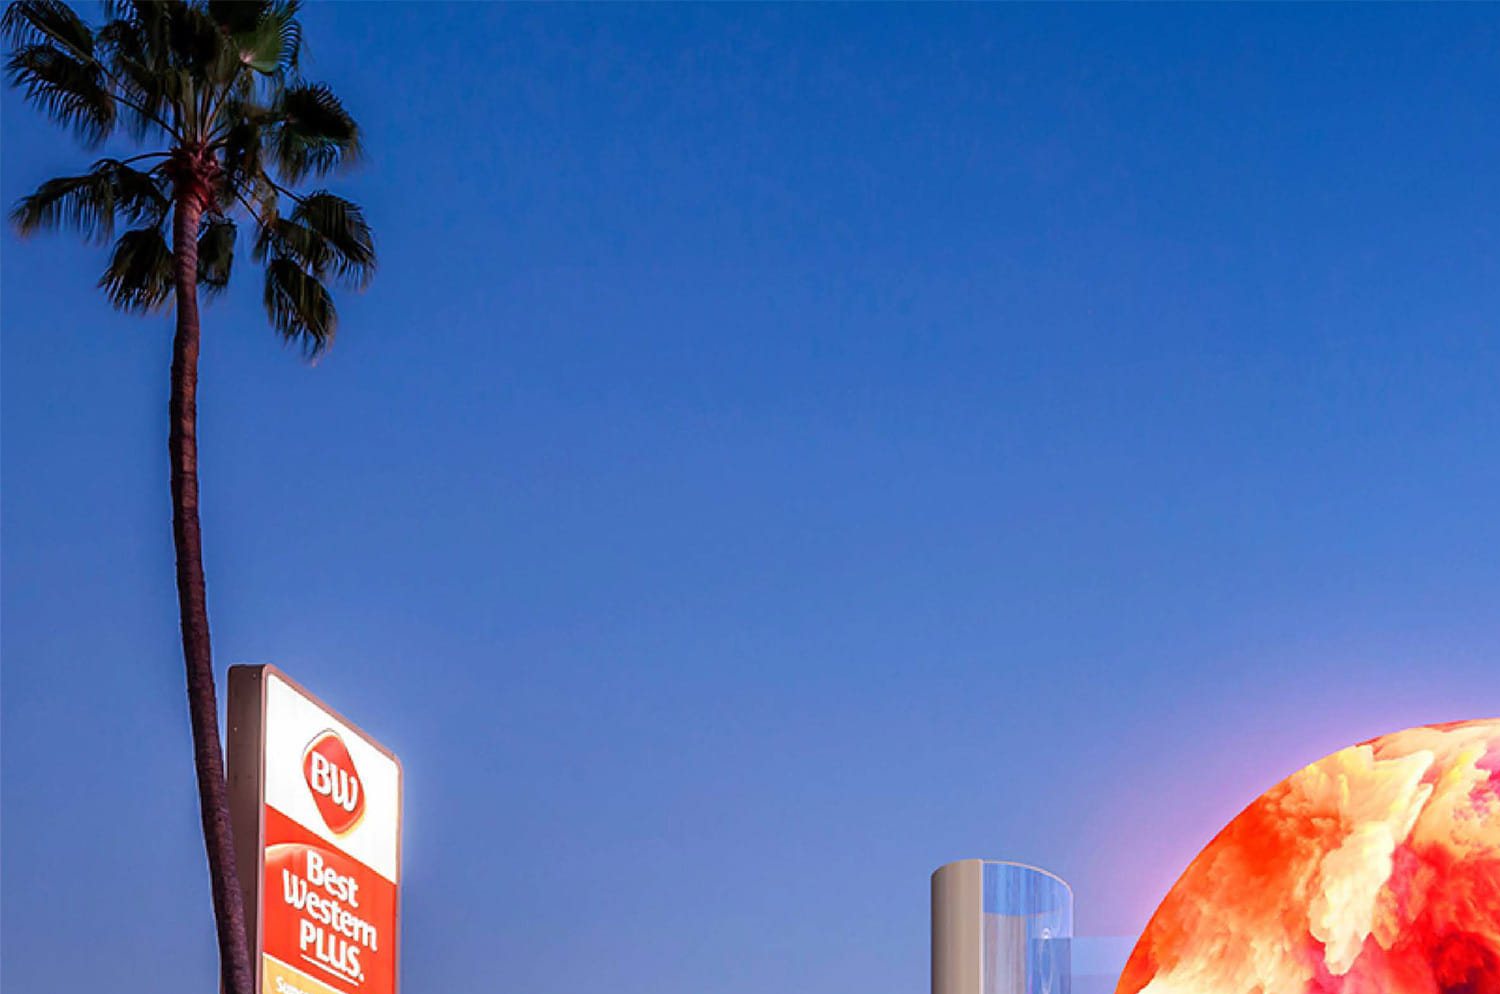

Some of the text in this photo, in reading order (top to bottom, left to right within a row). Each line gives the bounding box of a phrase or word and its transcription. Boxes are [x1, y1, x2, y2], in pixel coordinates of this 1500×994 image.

[311, 751, 359, 812] BW
[307, 849, 359, 908] Best
[283, 868, 378, 951] Western
